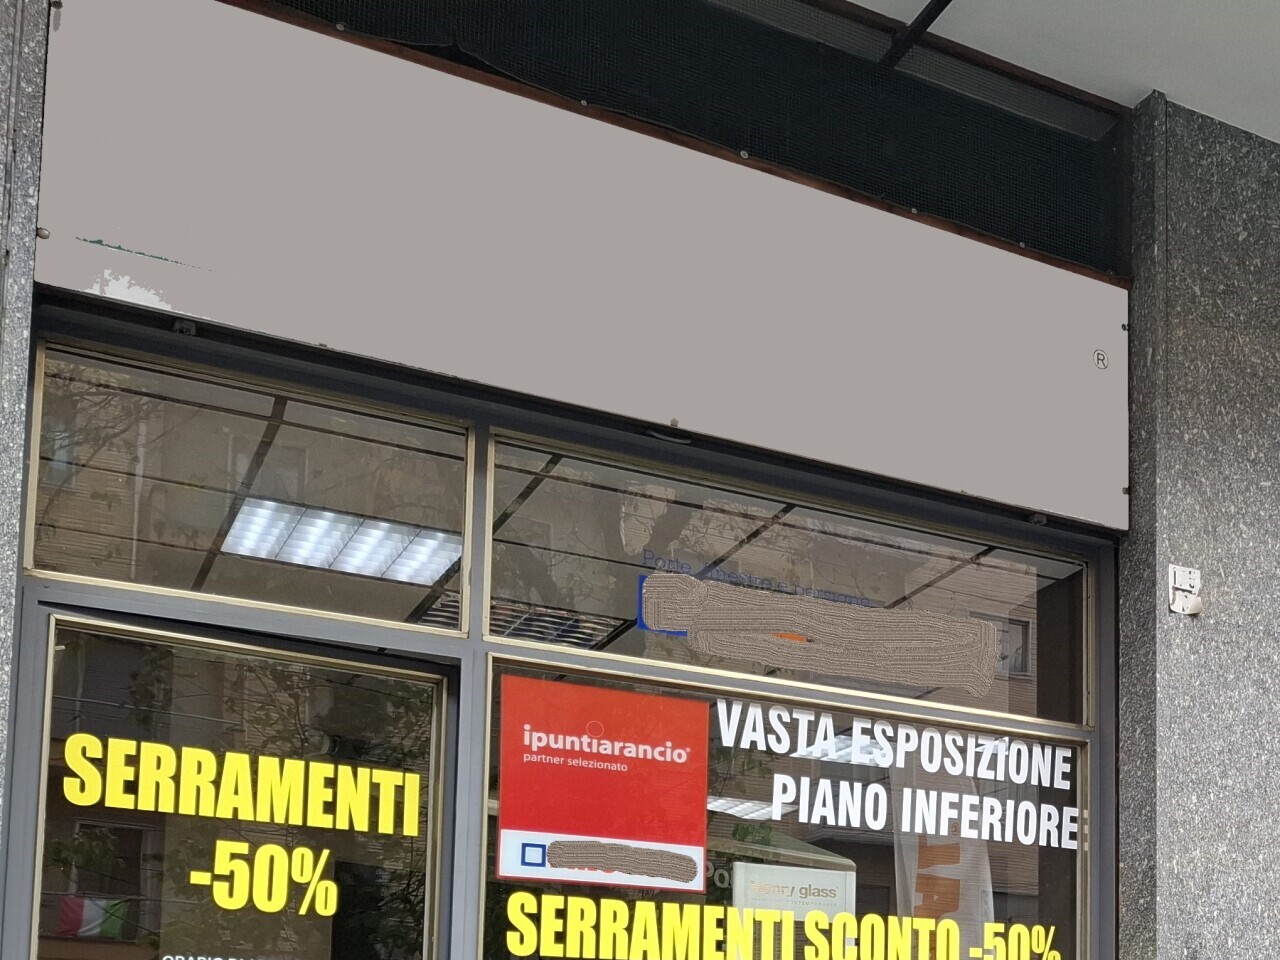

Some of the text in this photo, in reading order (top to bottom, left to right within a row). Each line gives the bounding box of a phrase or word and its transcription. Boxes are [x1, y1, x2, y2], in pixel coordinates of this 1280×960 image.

[523, 752, 628, 772] partner selezionato
[716, 699, 1073, 791] VASTA ESPOSIZIONE
[63, 733, 420, 837] SERRAMENTI
[772, 774, 1079, 851] PIANO INFERIORE
[189, 840, 338, 917] -50%
[799, 884, 838, 899] glass
